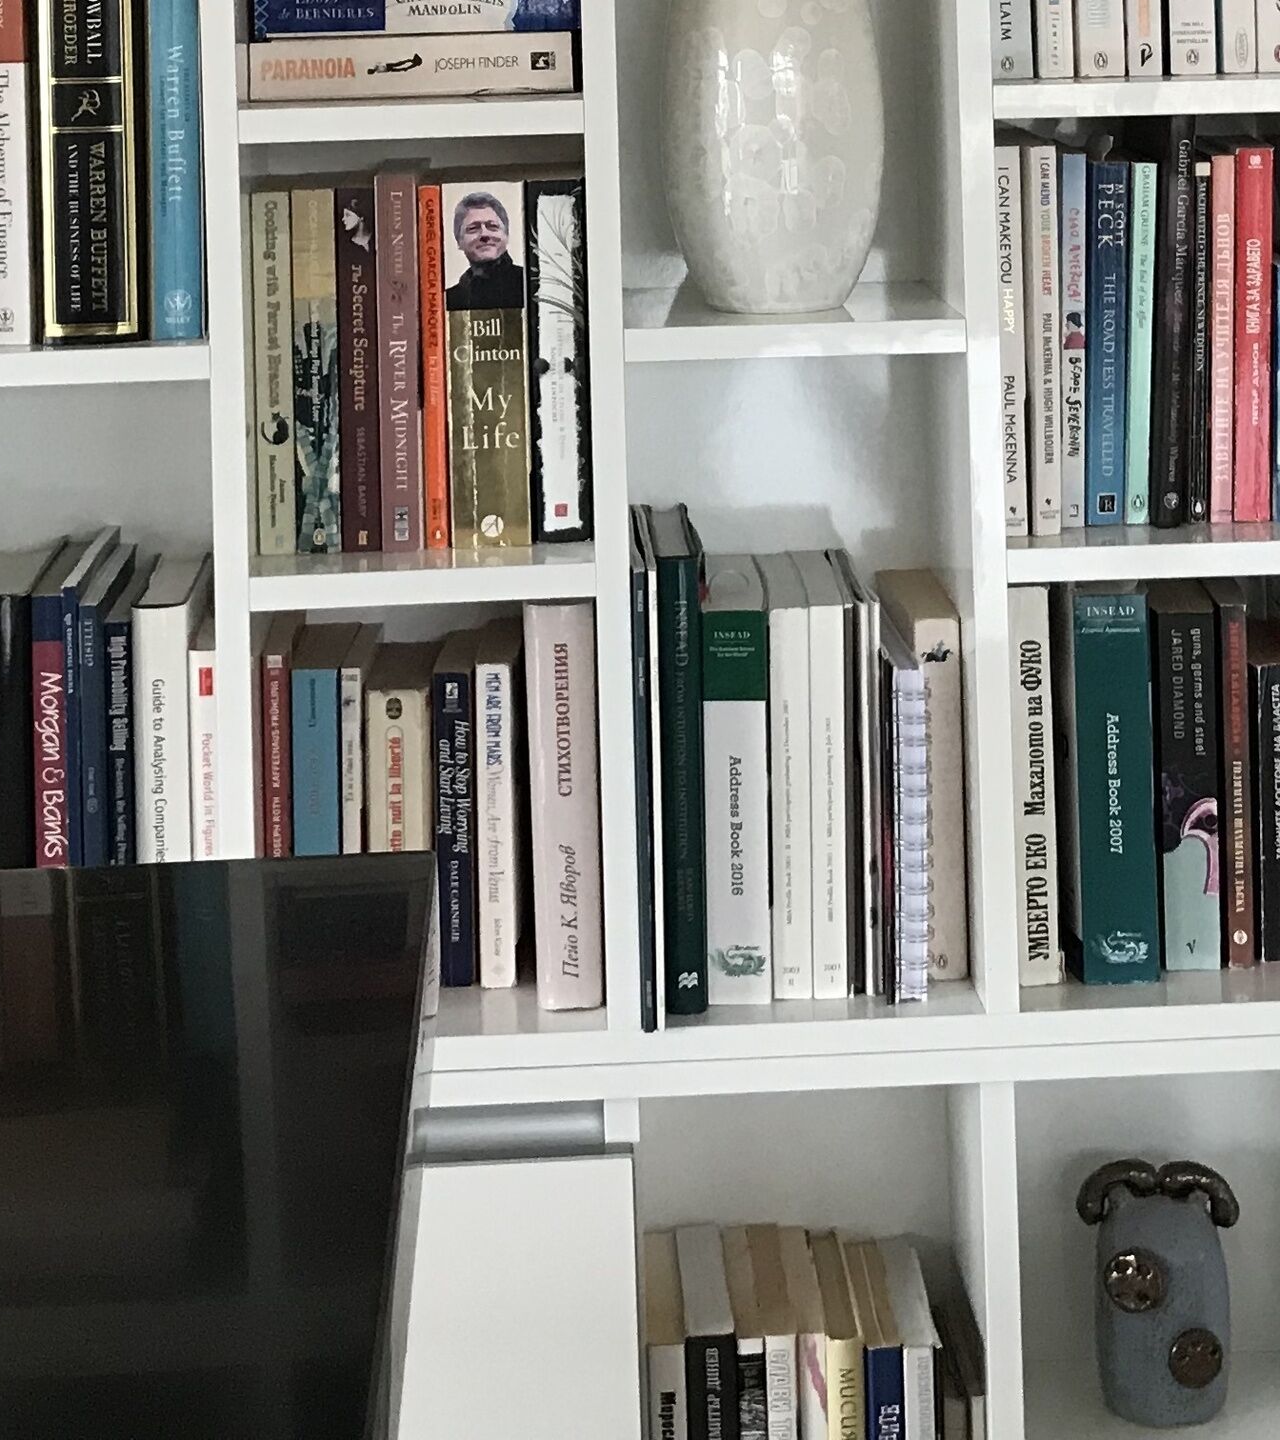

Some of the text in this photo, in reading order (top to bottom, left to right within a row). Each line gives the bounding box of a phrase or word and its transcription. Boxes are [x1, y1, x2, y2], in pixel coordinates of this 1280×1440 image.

[260, 57, 356, 81] PARANOIA
[434, 55, 519, 73] JOSEPH FINDER
[89, 141, 108, 312] WARREN BUFFETT
[1098, 184, 1114, 248] PECK
[472, 318, 502, 338] Bill
[1246, 239, 1262, 334] КНИГА ЗА ЗДРАВЕТО
[453, 345, 520, 364] Clinton
[467, 388, 513, 417] My
[461, 424, 520, 451] Life
[1004, 375, 1018, 484] PAUL McKENNA
[1086, 605, 1136, 617] INSEAD
[553, 642, 572, 797] СТИХОТВОРЕНИЯ
[1020, 639, 1045, 816] Махалото на ФУКО
[1171, 629, 1185, 740] JARED DIAMOND
[34, 671, 68, 858] Morgan & Banks
[150, 678, 168, 864] Guide to Analysing Companies
[437, 739, 454, 834] and Start Living
[452, 720, 470, 853] How to Stop Worrying
[1106, 713, 1123, 854] Address Book 2007
[729, 754, 744, 897] Address Book 2016
[1025, 833, 1050, 961] УМБЕРТО ЕКО
